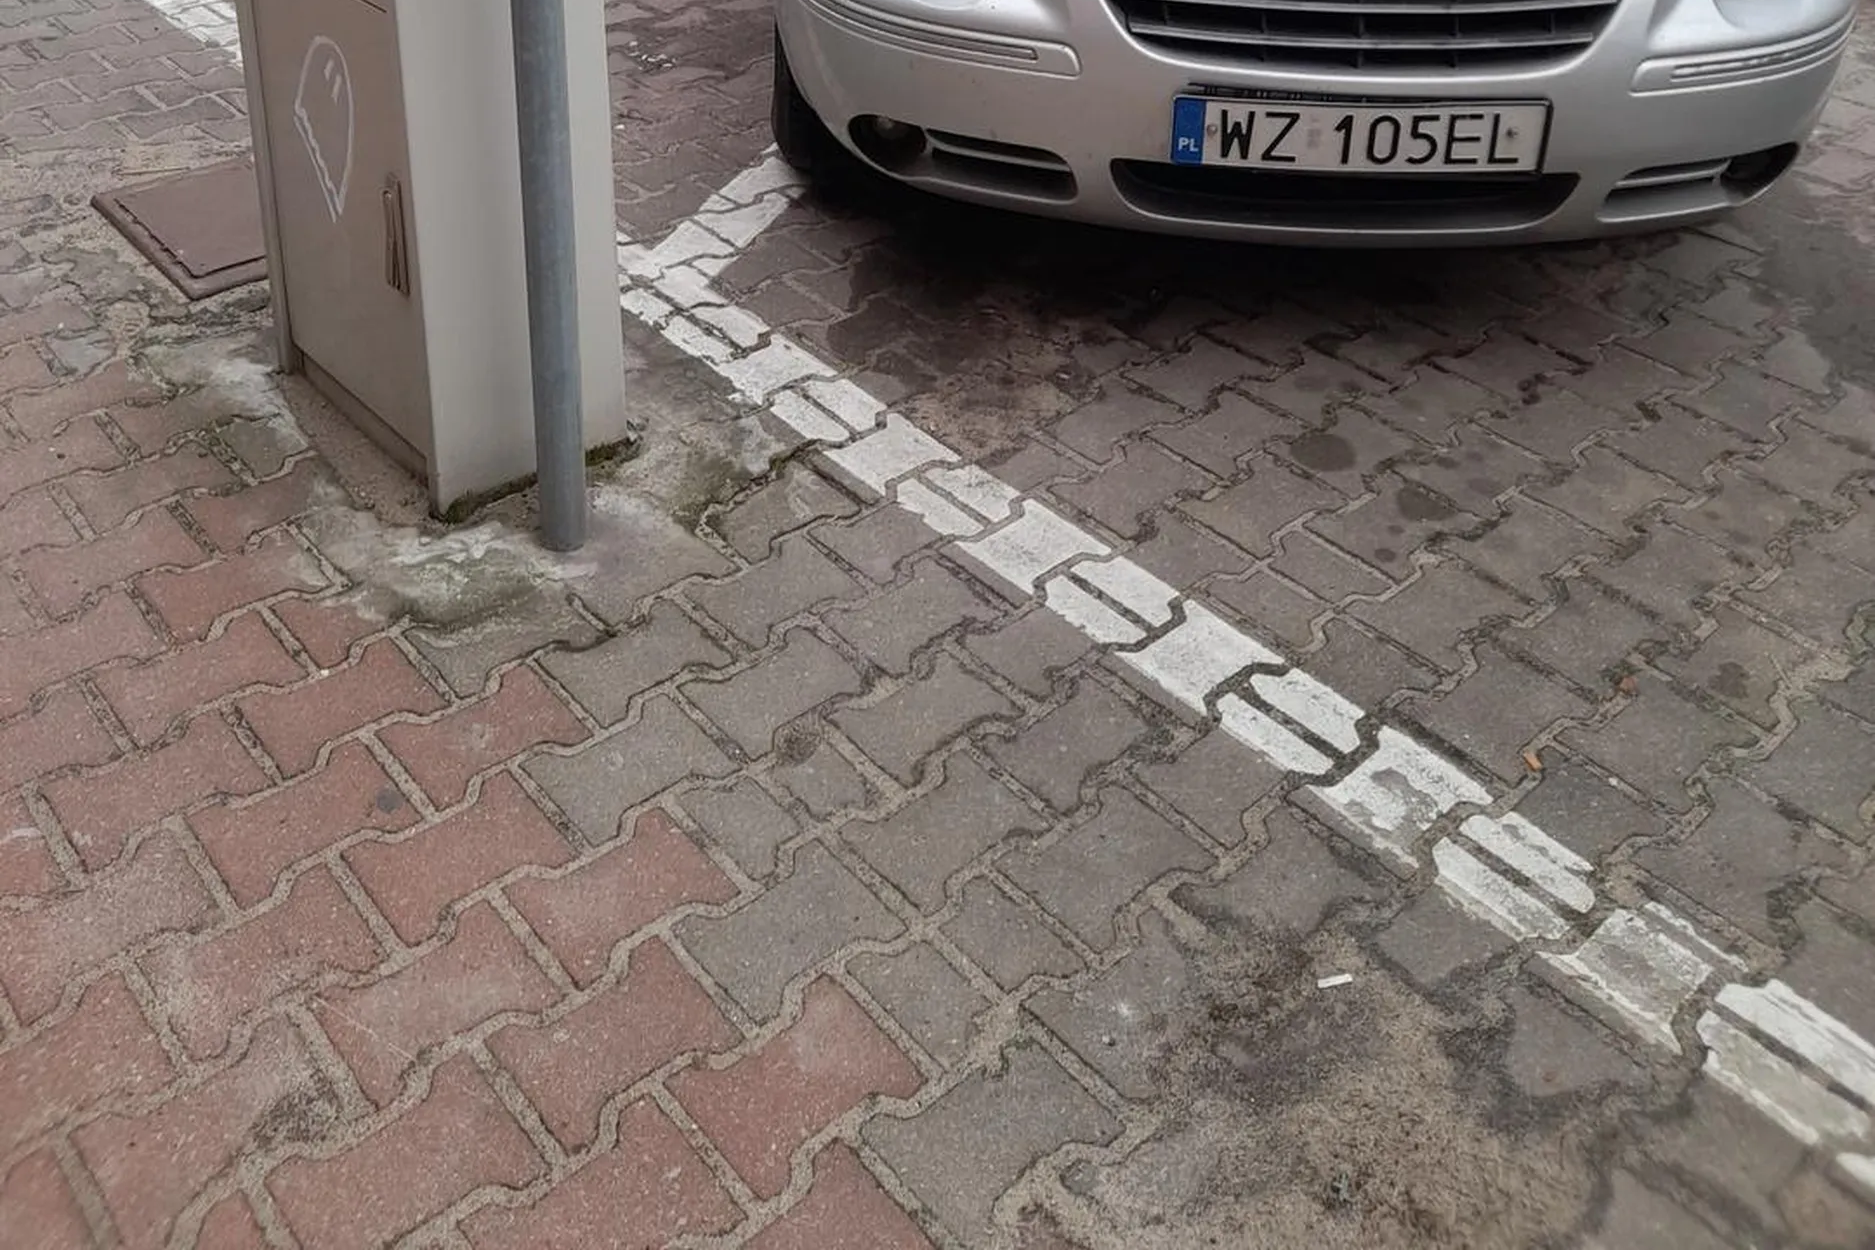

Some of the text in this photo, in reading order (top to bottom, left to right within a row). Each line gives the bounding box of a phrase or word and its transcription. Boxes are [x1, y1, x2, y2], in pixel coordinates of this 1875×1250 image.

[1178, 136, 1199, 153] PL
[1220, 108, 1520, 166] WZ 105EL
